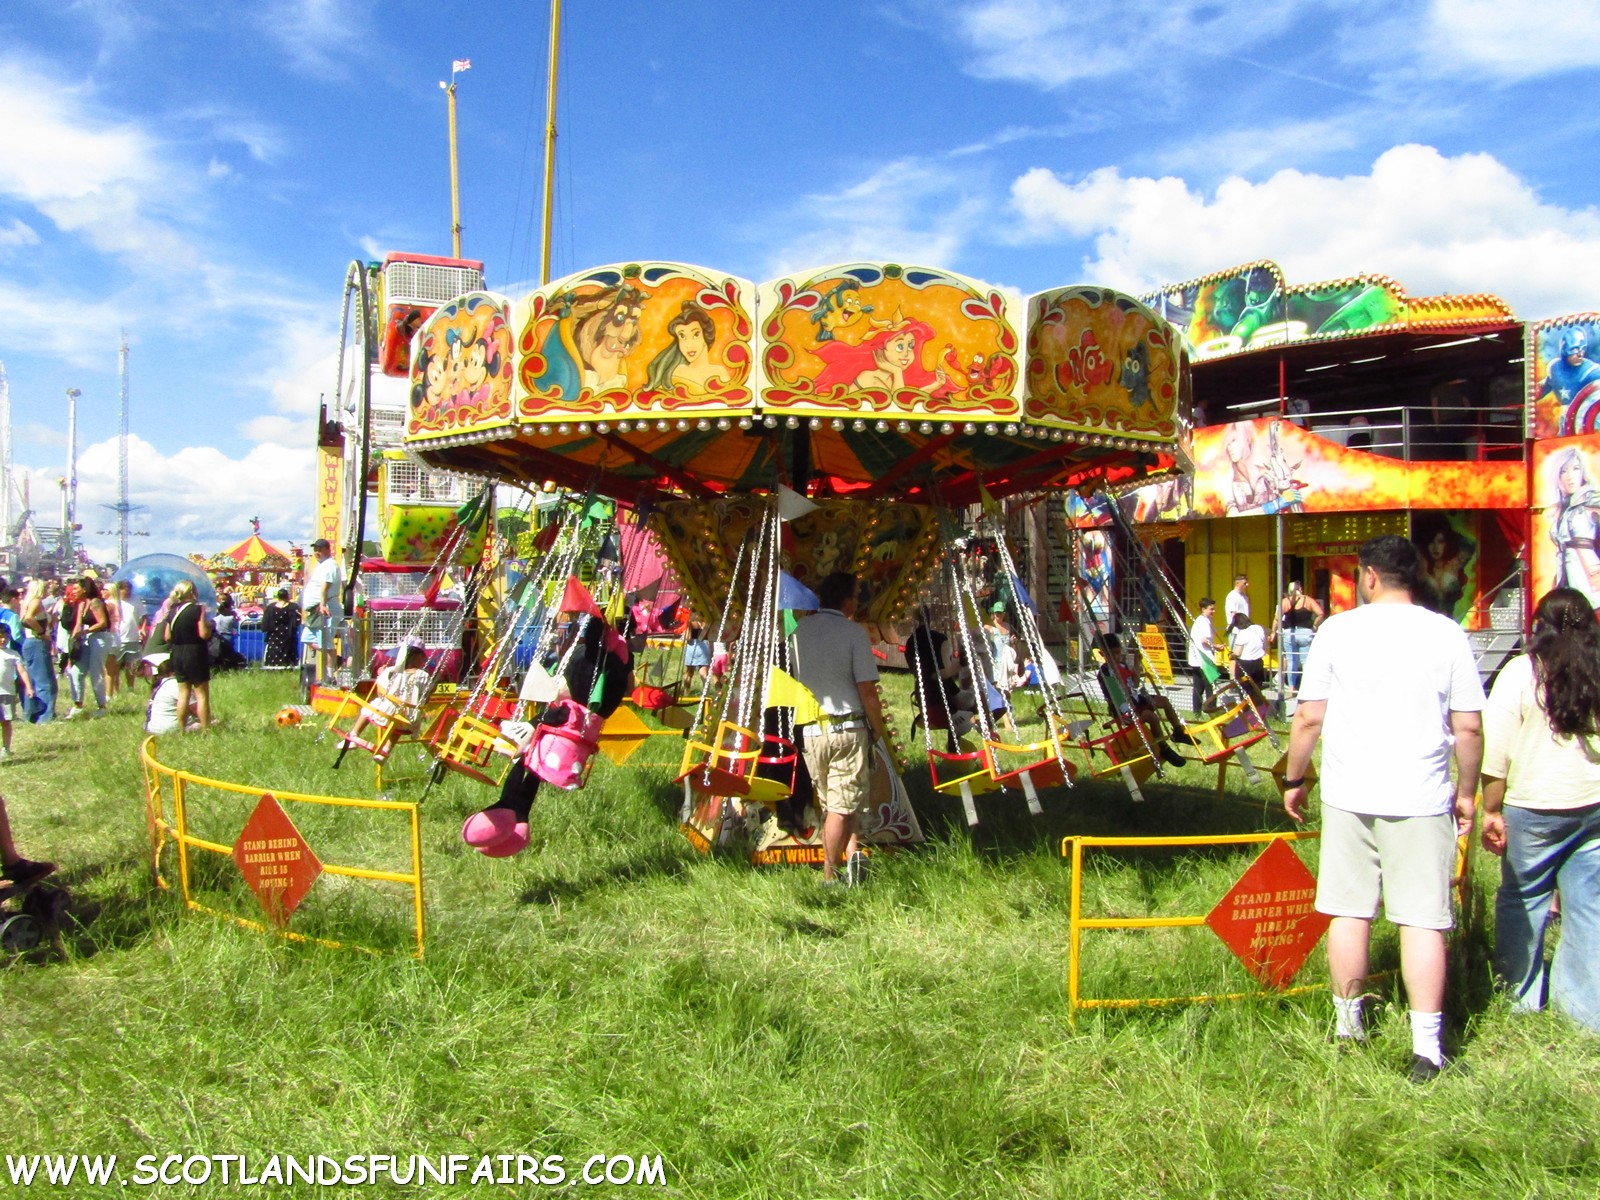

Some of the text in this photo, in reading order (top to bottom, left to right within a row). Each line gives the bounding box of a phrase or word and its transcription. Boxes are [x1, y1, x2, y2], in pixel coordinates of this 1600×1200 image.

[325, 454, 338, 505] MINI
[243, 838, 298, 850] STAND BEHIND
[245, 851, 301, 863] BARRIER WHEN
[786, 848, 824, 863] WHILE
[260, 865, 288, 876] RIDE IS
[1233, 892, 1271, 906] STAND
[1232, 907, 1282, 921] BARRIER
[1254, 919, 1297, 934] RIDE IS
[1250, 933, 1294, 949] MOVING
